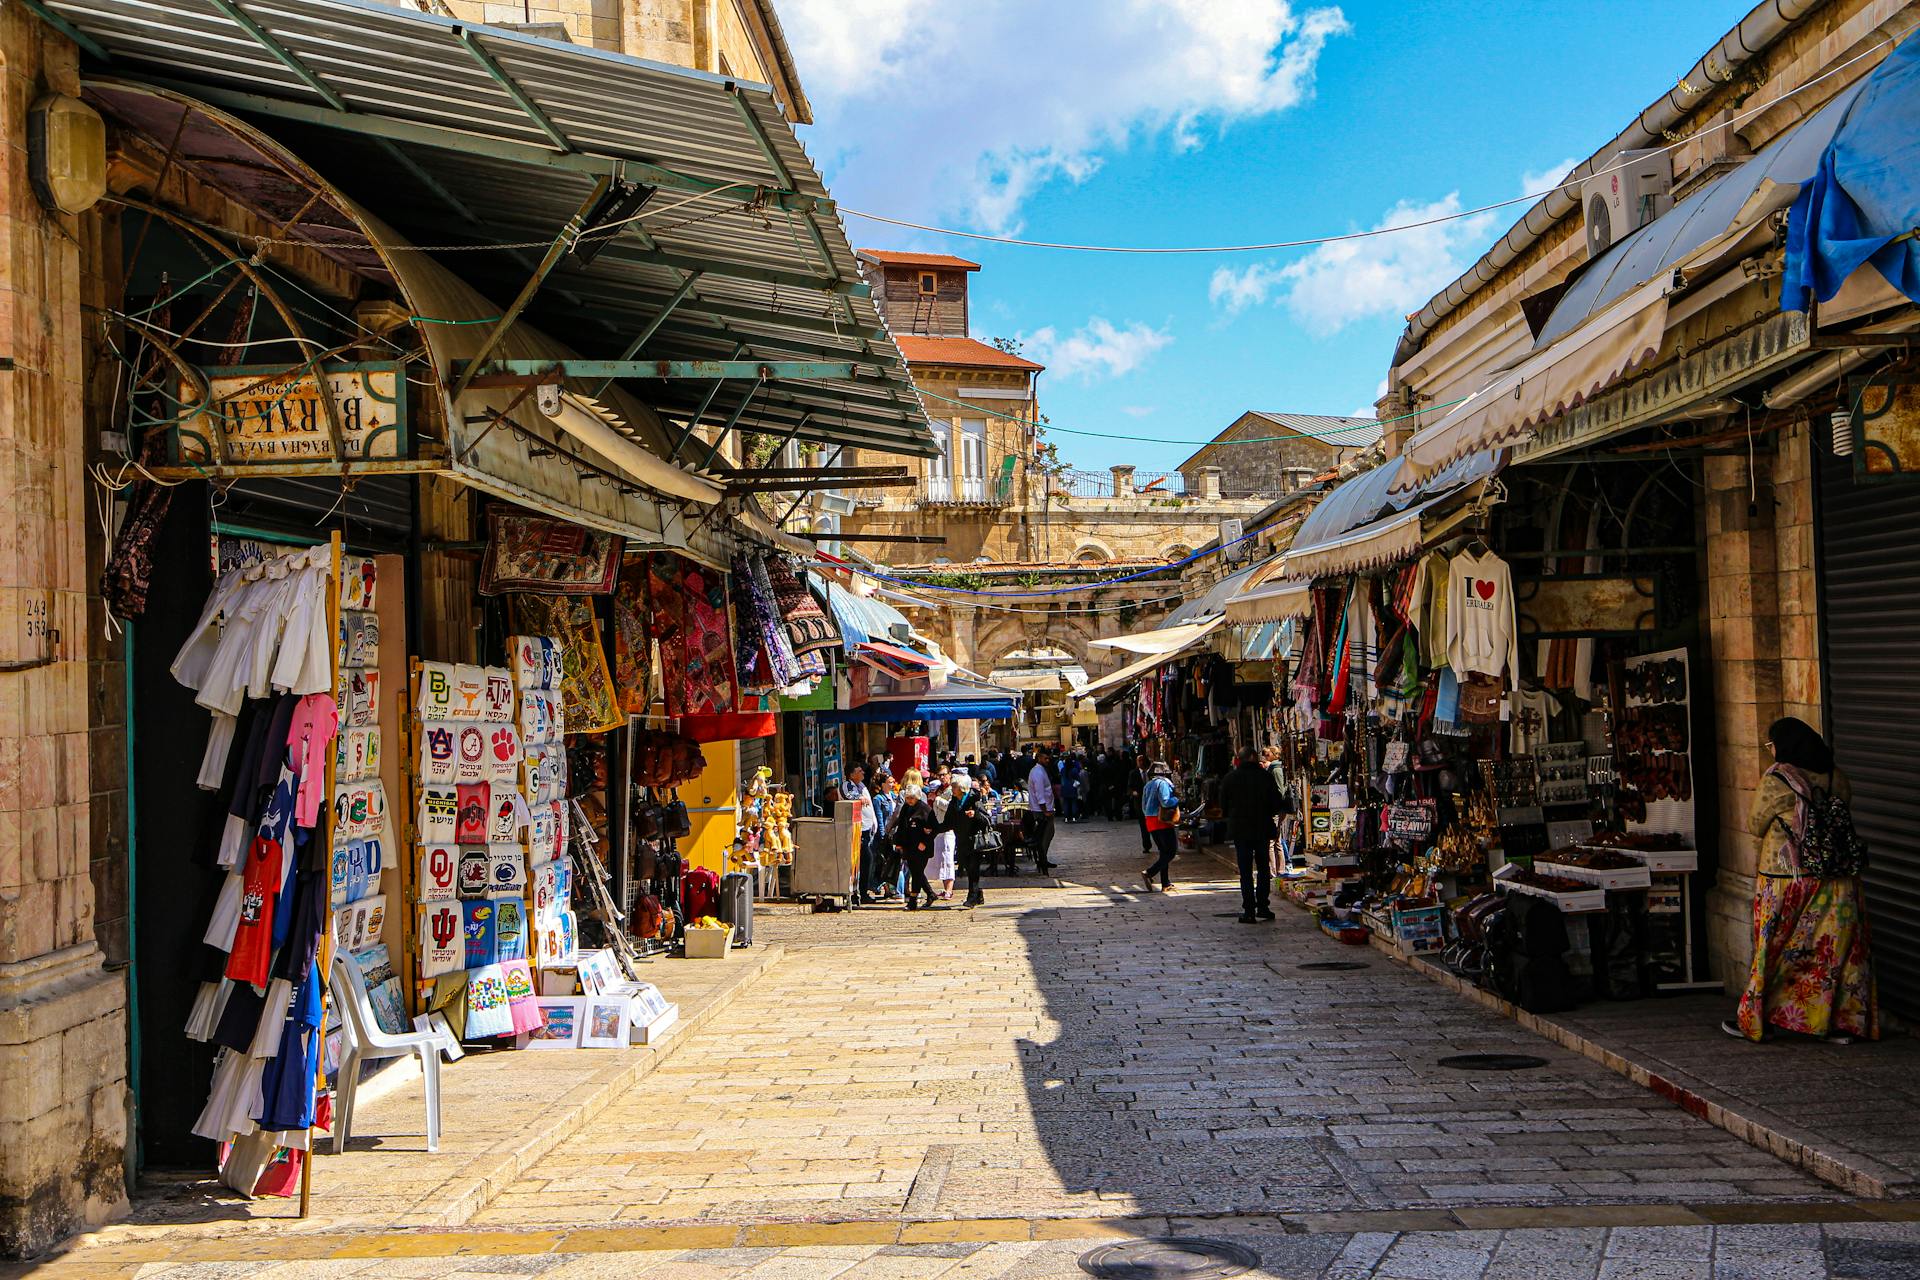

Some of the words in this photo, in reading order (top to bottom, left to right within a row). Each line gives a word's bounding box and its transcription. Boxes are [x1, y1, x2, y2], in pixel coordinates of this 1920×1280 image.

[220, 398, 364, 434] BRAKAT
[228, 441, 276, 454] BAZAA
[281, 439, 361, 453] DABAGHA
[26, 599, 46, 616] 243
